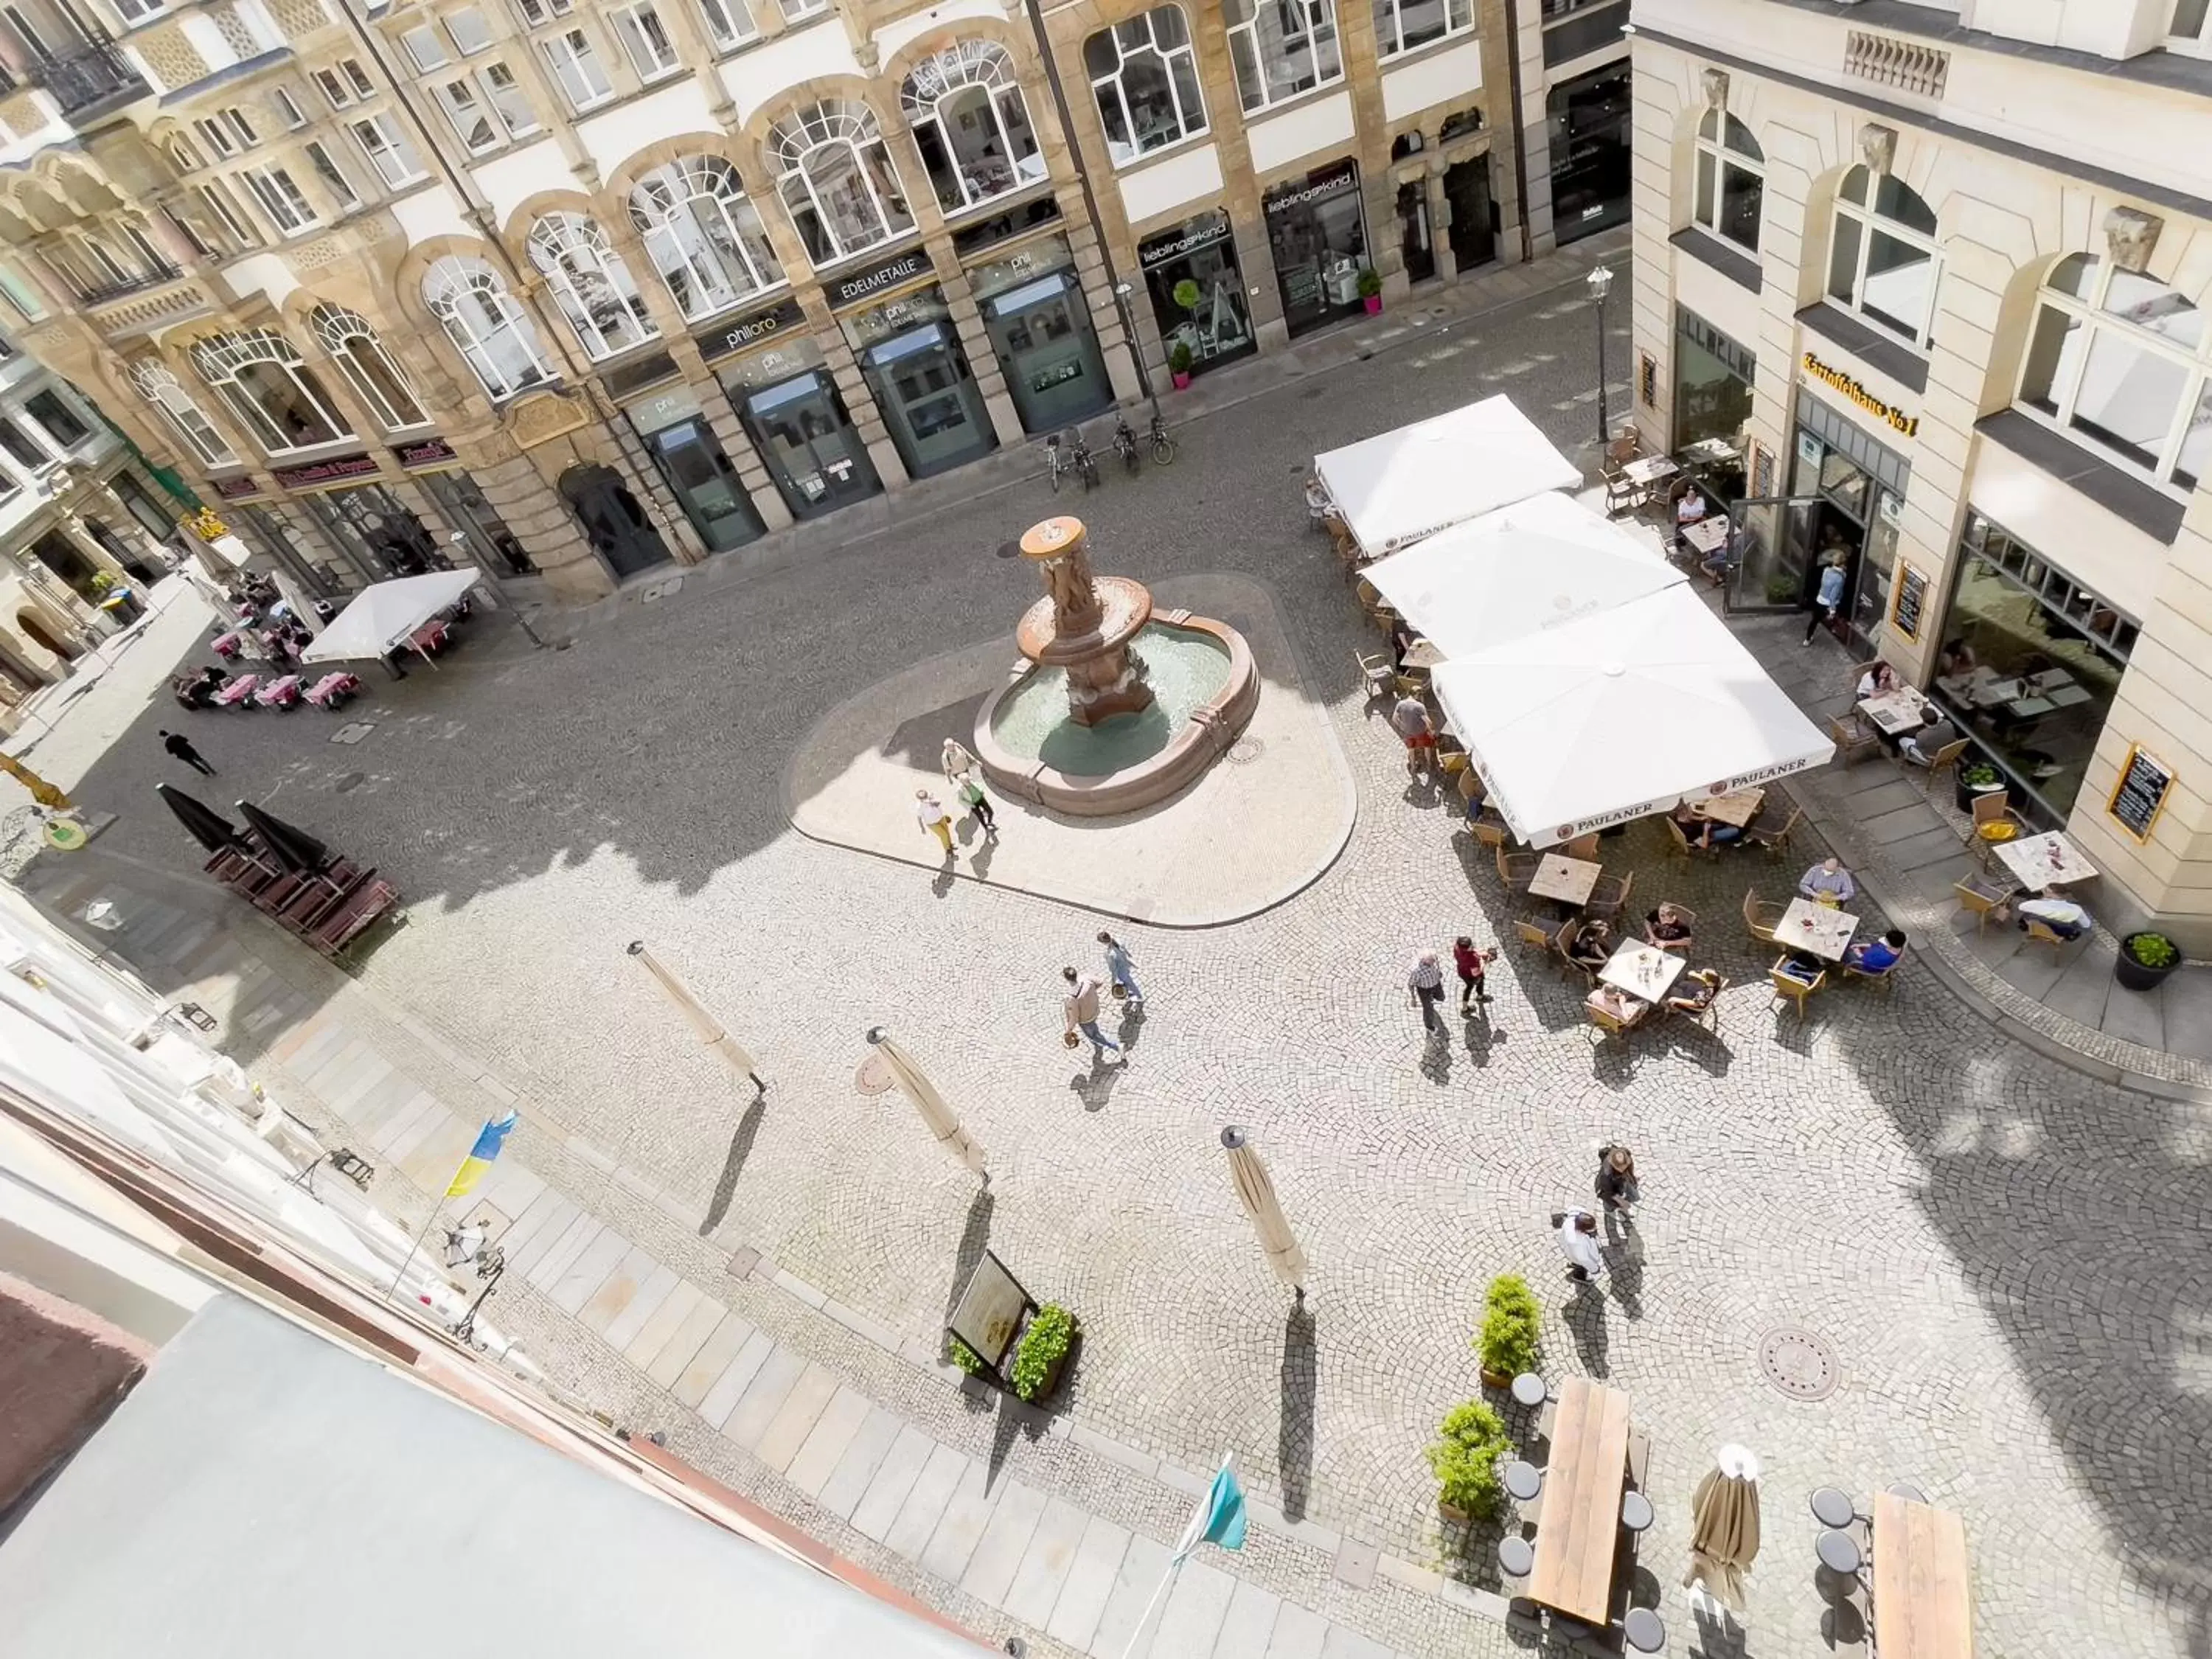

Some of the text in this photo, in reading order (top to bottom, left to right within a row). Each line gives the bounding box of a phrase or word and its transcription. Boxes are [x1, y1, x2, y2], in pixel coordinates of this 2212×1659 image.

[841, 259, 917, 299] EDELMETALLE
[726, 318, 776, 349] philoro
[1802, 352, 1887, 418] Kartoffelhaus
[1732, 758, 1806, 788] PAULANER
[1578, 803, 1652, 832] PAULANER
